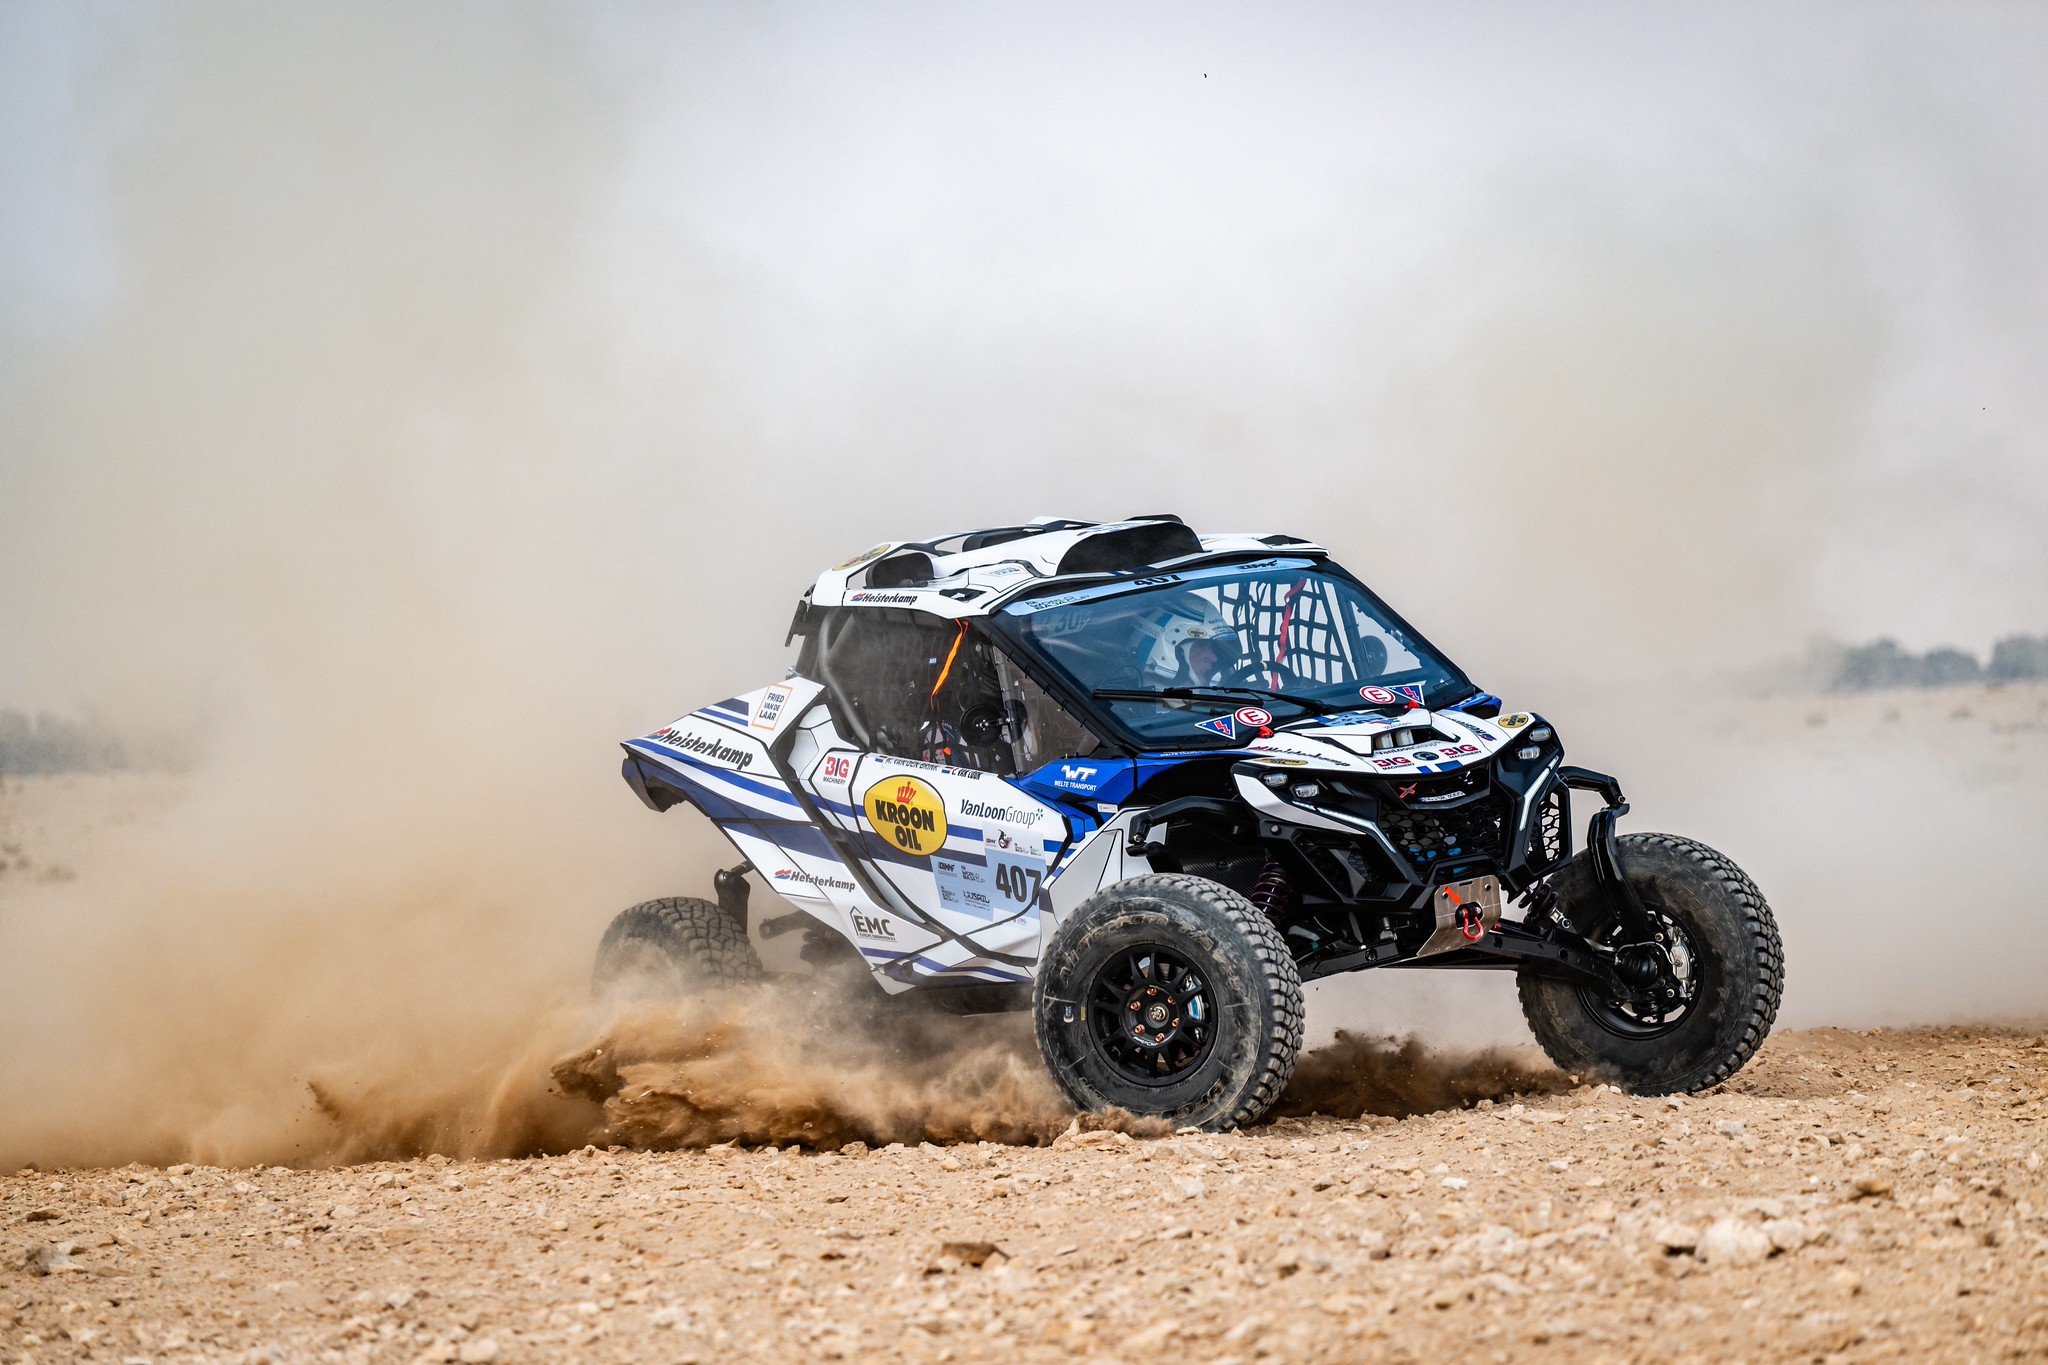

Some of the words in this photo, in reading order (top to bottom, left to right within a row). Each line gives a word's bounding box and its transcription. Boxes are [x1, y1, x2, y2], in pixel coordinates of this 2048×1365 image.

[1133, 574, 1182, 587] 407
[862, 592, 918, 606] Heisterkamp
[767, 692, 785, 703] FRIED
[759, 710, 777, 721] LAAR
[659, 729, 753, 770] Heisterkamp
[823, 776, 847, 785] MACHINERY
[1061, 765, 1097, 782] WT
[1054, 780, 1069, 789] WELTE
[1069, 782, 1097, 792] TRANSPORT
[875, 799, 935, 832] KROON
[961, 799, 1035, 829] VanLoonGroup
[895, 825, 922, 851] OIL
[790, 871, 856, 892] Heisterkamp
[995, 862, 1042, 906] 407
[853, 915, 895, 937] EMC
